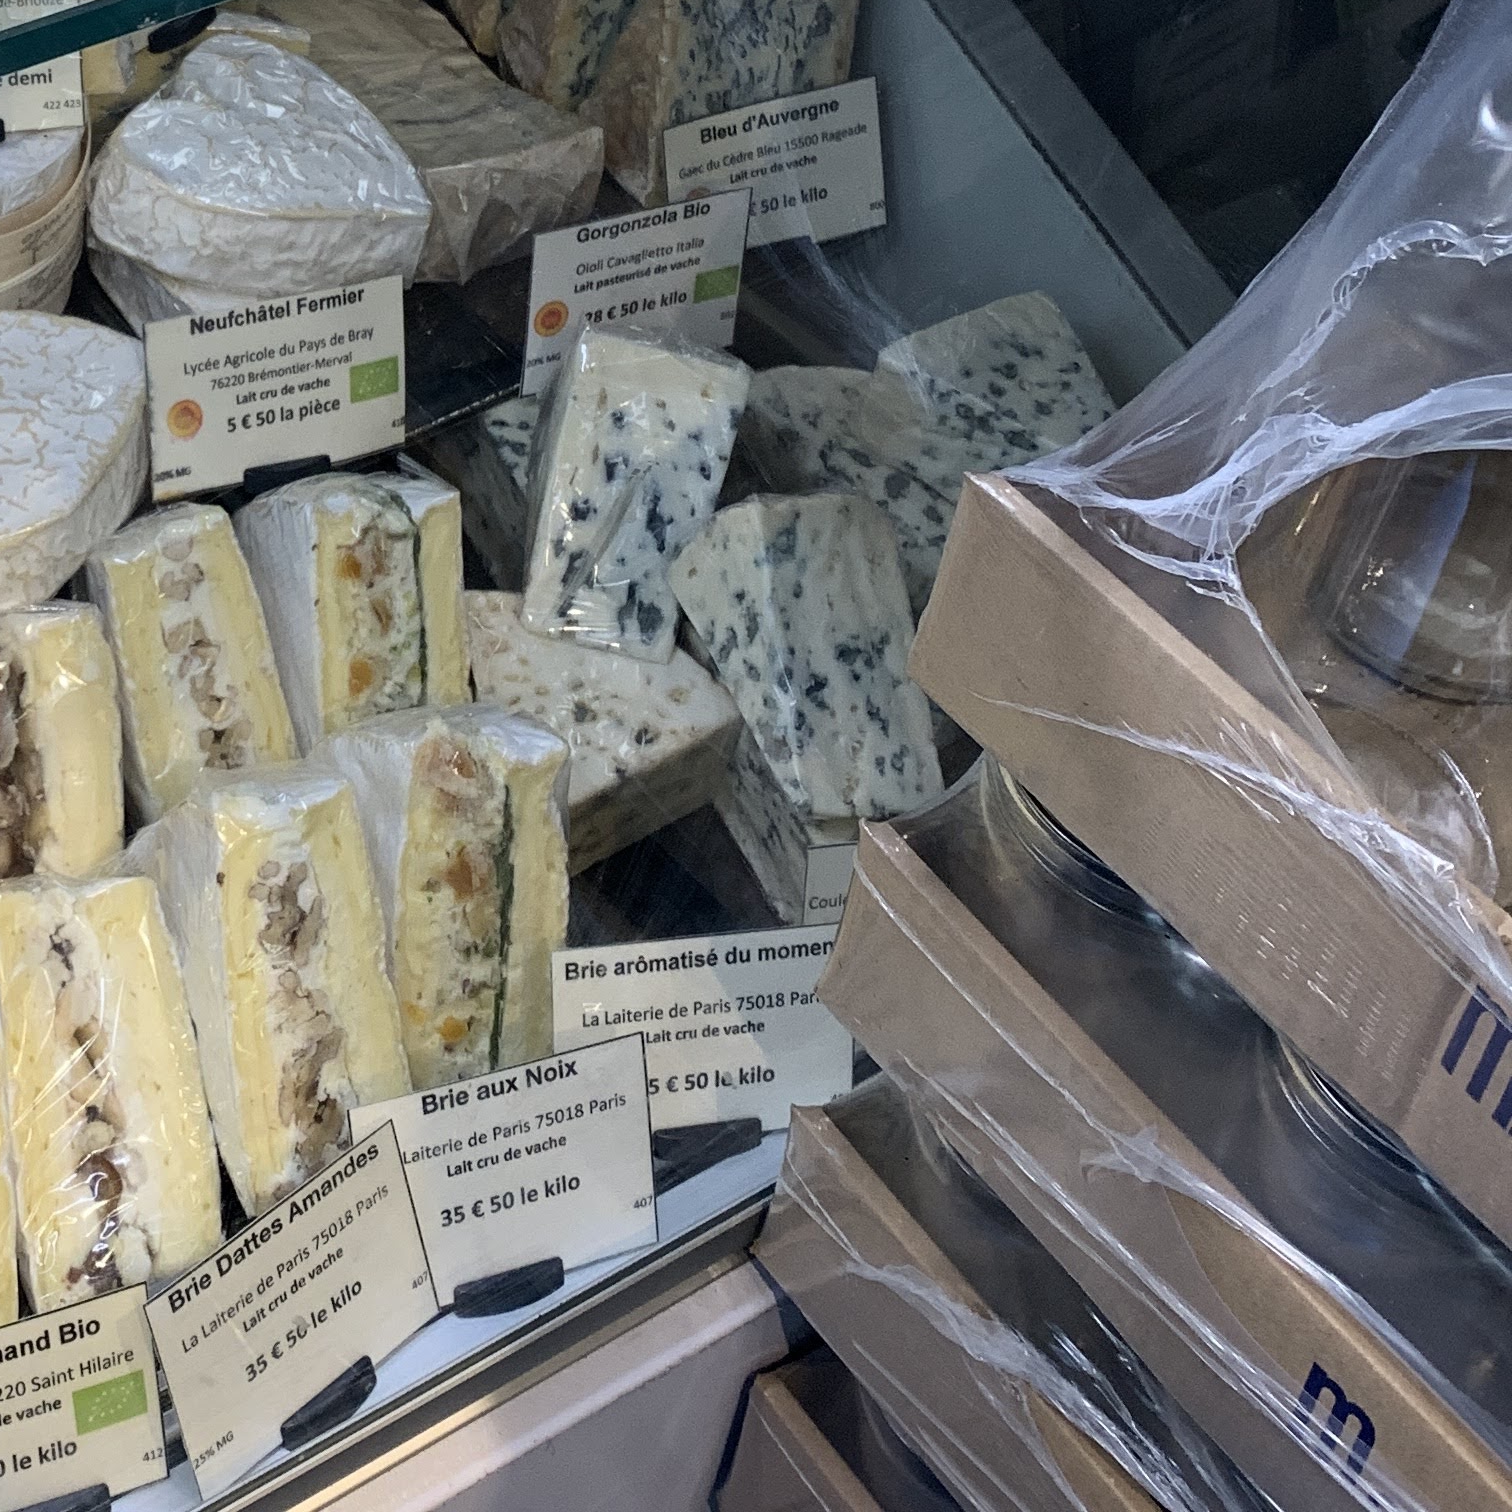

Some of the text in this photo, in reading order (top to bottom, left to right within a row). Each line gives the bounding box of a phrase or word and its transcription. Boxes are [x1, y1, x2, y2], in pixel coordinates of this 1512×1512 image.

[700, 99, 840, 144] Bleu d'Auvergne
[678, 163, 705, 180] Gaec
[706, 159, 721, 172] du
[722, 151, 755, 167] Cèdre
[757, 144, 781, 158] Bleu
[784, 135, 819, 152] 15500
[576, 202, 711, 244] Gorgonzola Bio
[607, 245, 674, 269] Cavaglietto
[676, 237, 705, 252] Italia
[189, 288, 365, 335] Neufchâtel Fermier
[183, 326, 374, 376] Lycée Agricole du Pays de Bray
[210, 351, 353, 391] 76220 Brémontier-Merval
[564, 940, 836, 981] Brie arômatisé du momen
[421, 1059, 578, 1116] Brie aux Noix
[633, 1195, 653, 1210] 407
[167, 1142, 380, 1314] Brie Dattes Amandes
[59, 1318, 101, 1345] Bio
[31, 1366, 75, 1393] Saint
[79, 1348, 135, 1377] Hilaire
[142, 1447, 164, 1463] 412
